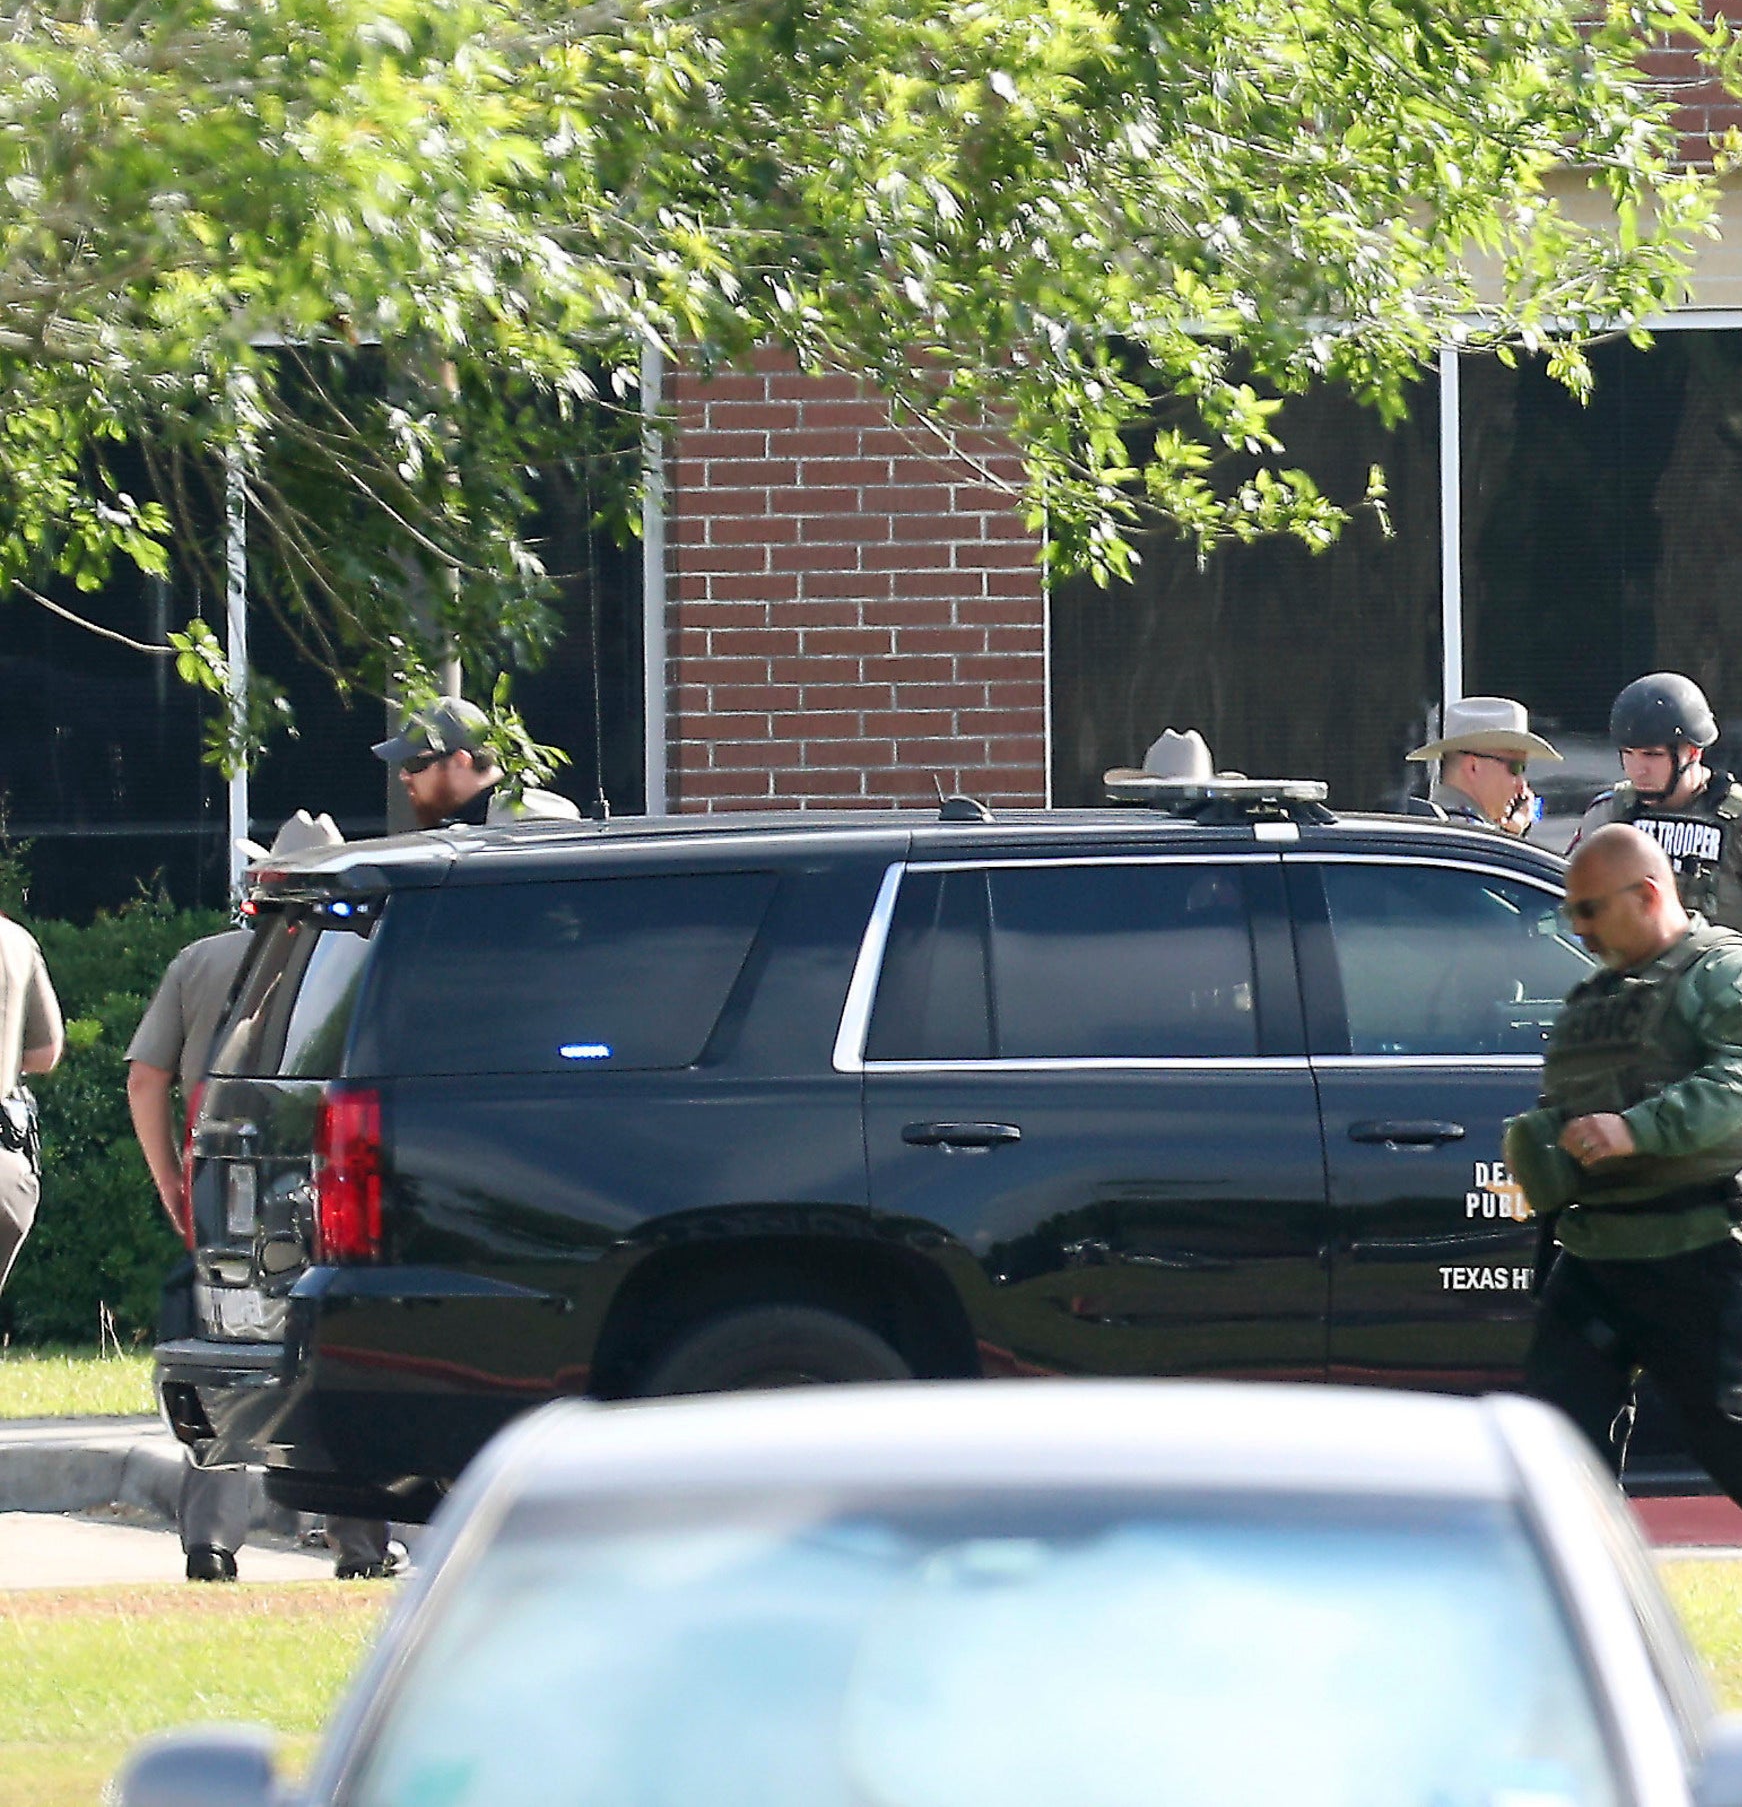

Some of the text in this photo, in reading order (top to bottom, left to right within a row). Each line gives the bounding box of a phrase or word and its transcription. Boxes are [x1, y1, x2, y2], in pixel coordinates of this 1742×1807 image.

[1658, 821, 1721, 861] TROOPER
[1466, 1192, 1536, 1218] PUBL
[1439, 1267, 1509, 1290] TEXAS
